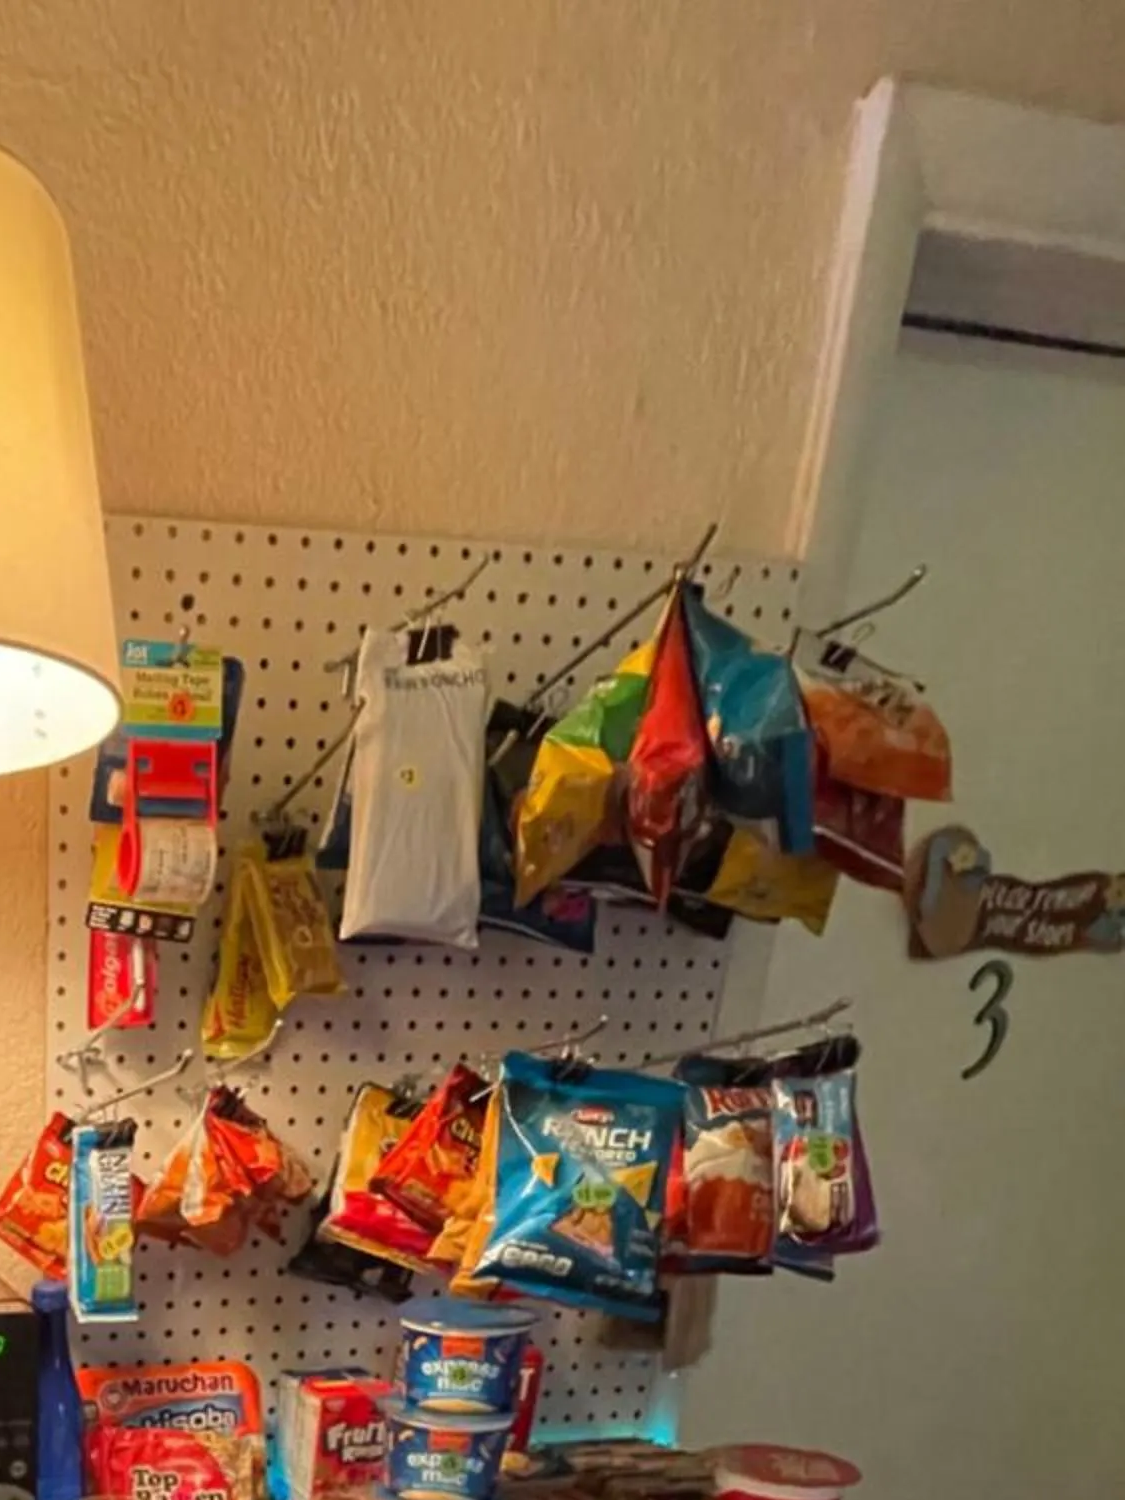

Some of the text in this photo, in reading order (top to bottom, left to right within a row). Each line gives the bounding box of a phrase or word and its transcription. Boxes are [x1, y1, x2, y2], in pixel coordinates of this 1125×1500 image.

[961, 959, 1013, 1080] 3
[541, 1115, 653, 1150] RNCH
[121, 1373, 234, 1396] Maruchan
[133, 1468, 179, 1493] Top
